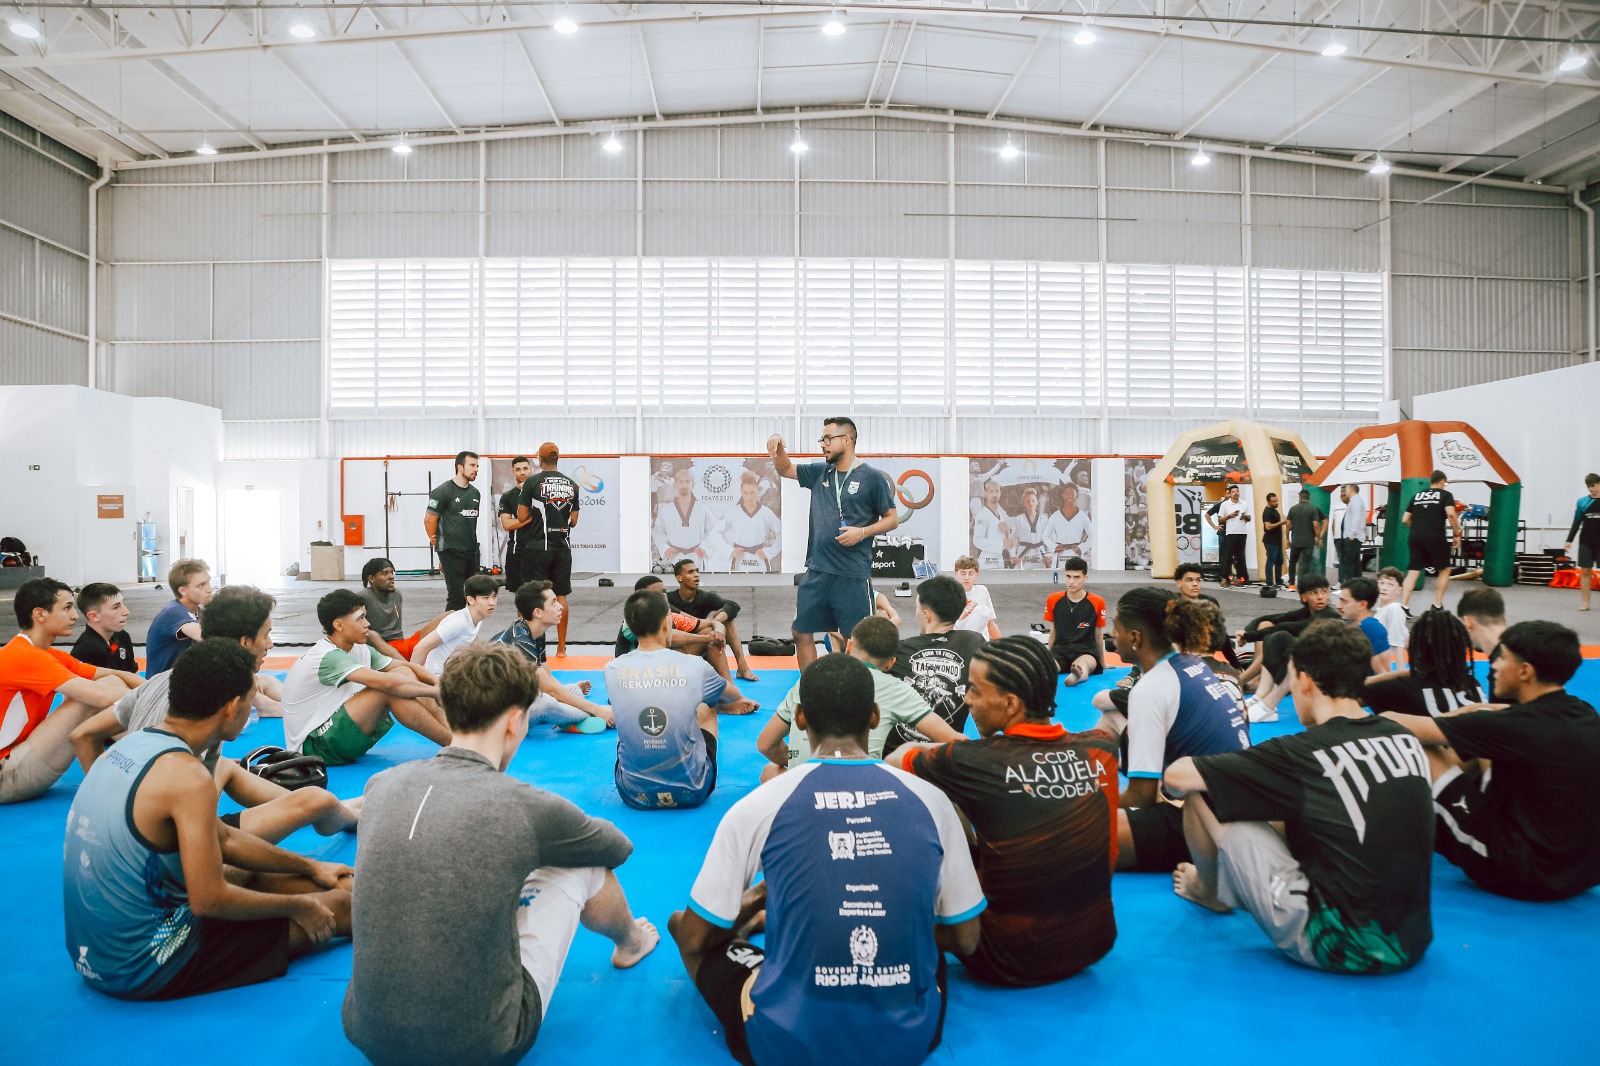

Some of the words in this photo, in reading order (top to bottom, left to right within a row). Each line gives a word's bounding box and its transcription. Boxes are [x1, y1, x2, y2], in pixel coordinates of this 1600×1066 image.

[1188, 454, 1239, 465] POWERFIT
[542, 483, 575, 497] TRAINING
[549, 491, 569, 500] CAMP
[1414, 491, 1441, 501] USA
[579, 495, 606, 506] o2016
[617, 665, 685, 680] BRASIL
[915, 661, 959, 677] TAEKWONDO
[618, 678, 687, 689] TAEKWONDO
[1032, 749, 1079, 765] CCDR
[1006, 759, 1107, 784] ALAJUELA
[1036, 781, 1095, 799] CODEA
[814, 791, 866, 809] JERJ
[846, 816, 872, 824] Parceria
[842, 900, 873, 909] Secretaria
[874, 901, 883, 909] de
[839, 908, 863, 917] Esporte
[869, 909, 887, 917] Lazer
[815, 965, 859, 975] GOVERNO
[862, 966, 873, 975] DO
[877, 963, 911, 975] ESTADO
[815, 974, 839, 987] RIO
[840, 973, 858, 987] DE
[859, 971, 911, 988] JANEIRO
